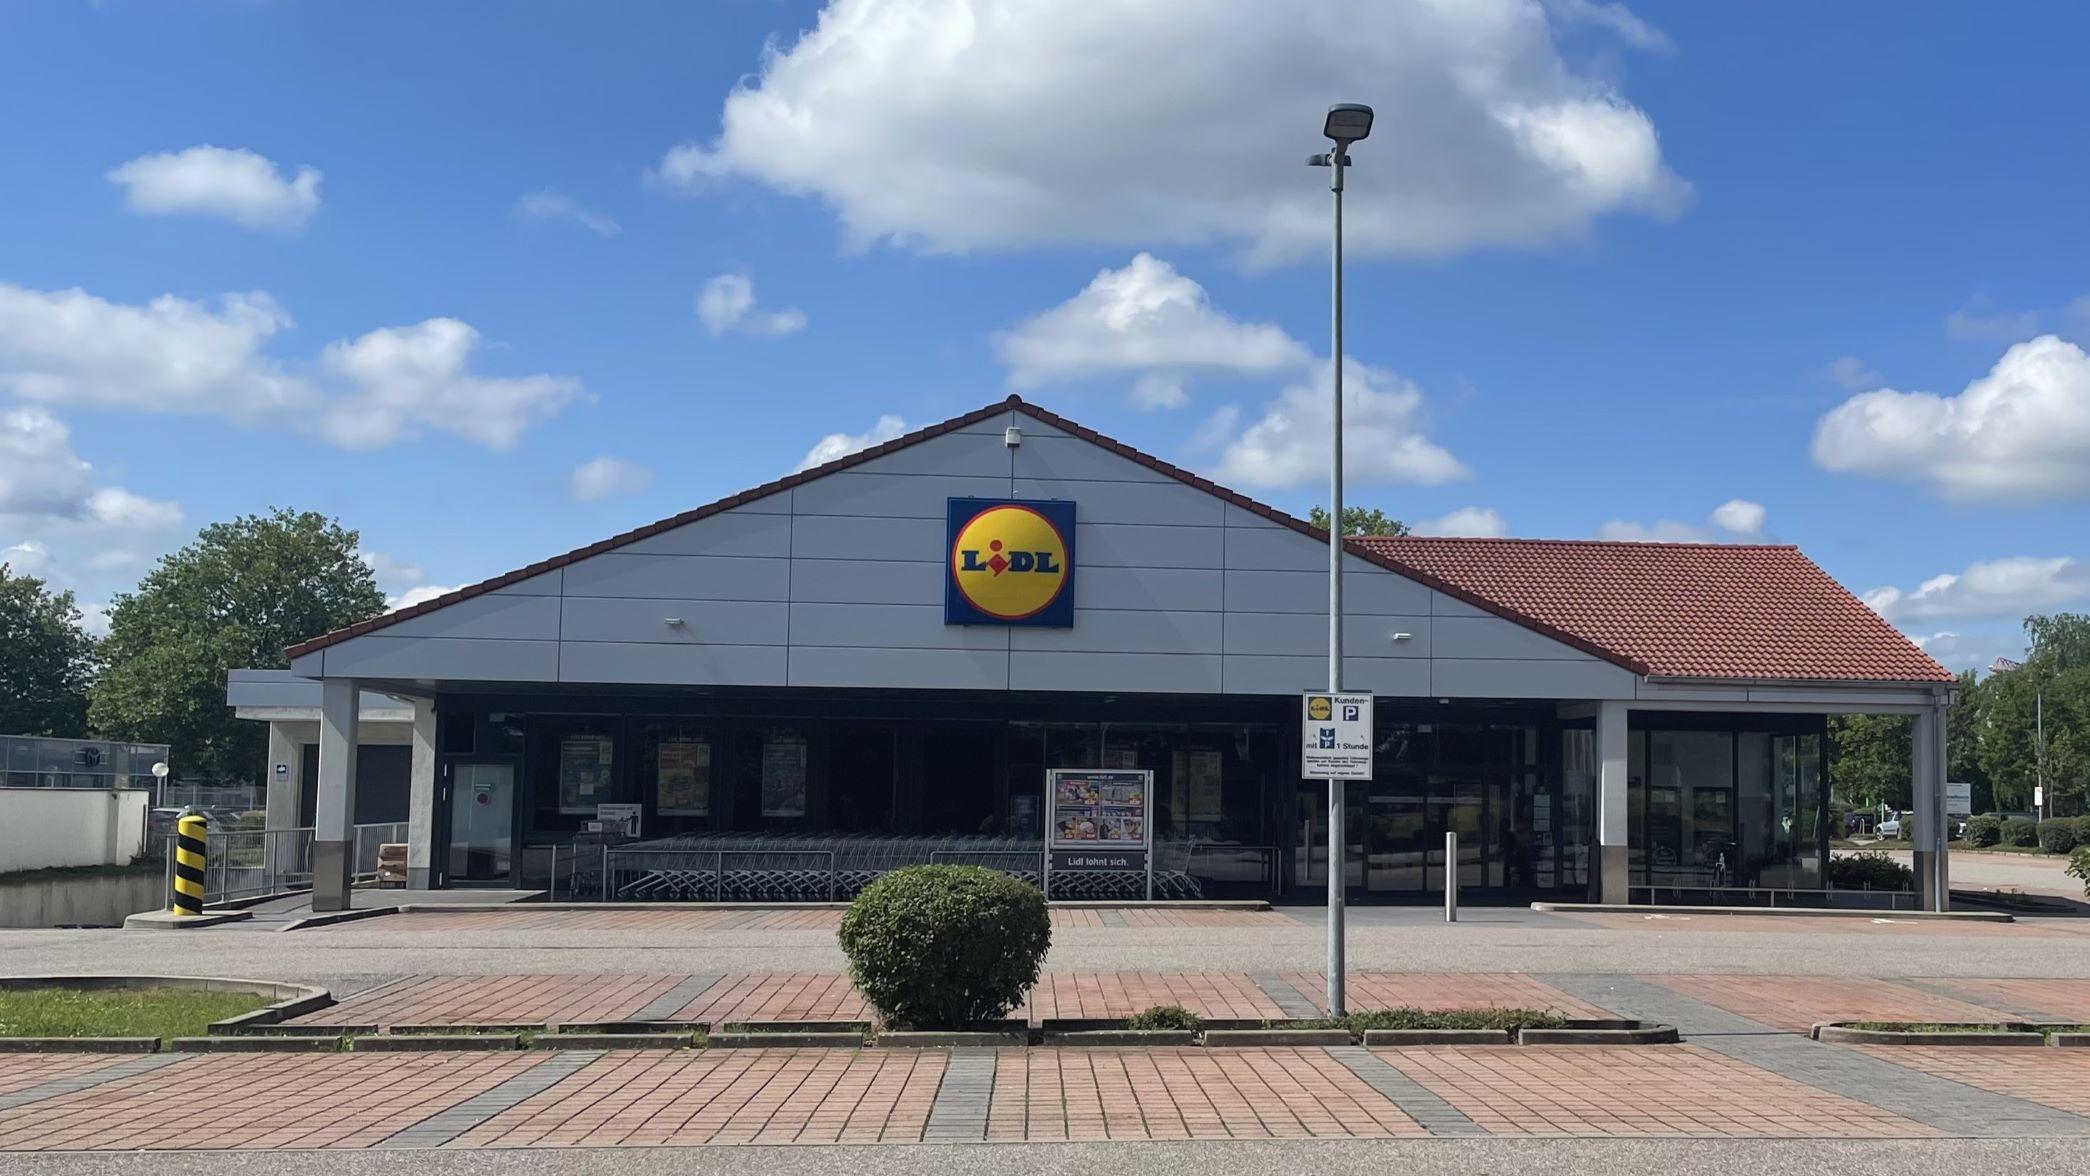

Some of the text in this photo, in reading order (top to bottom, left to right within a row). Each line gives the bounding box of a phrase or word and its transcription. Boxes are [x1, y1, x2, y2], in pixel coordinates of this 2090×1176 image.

[1345, 706, 1357, 720] P
[1068, 857, 1129, 866] Lidl lohnt sich.
